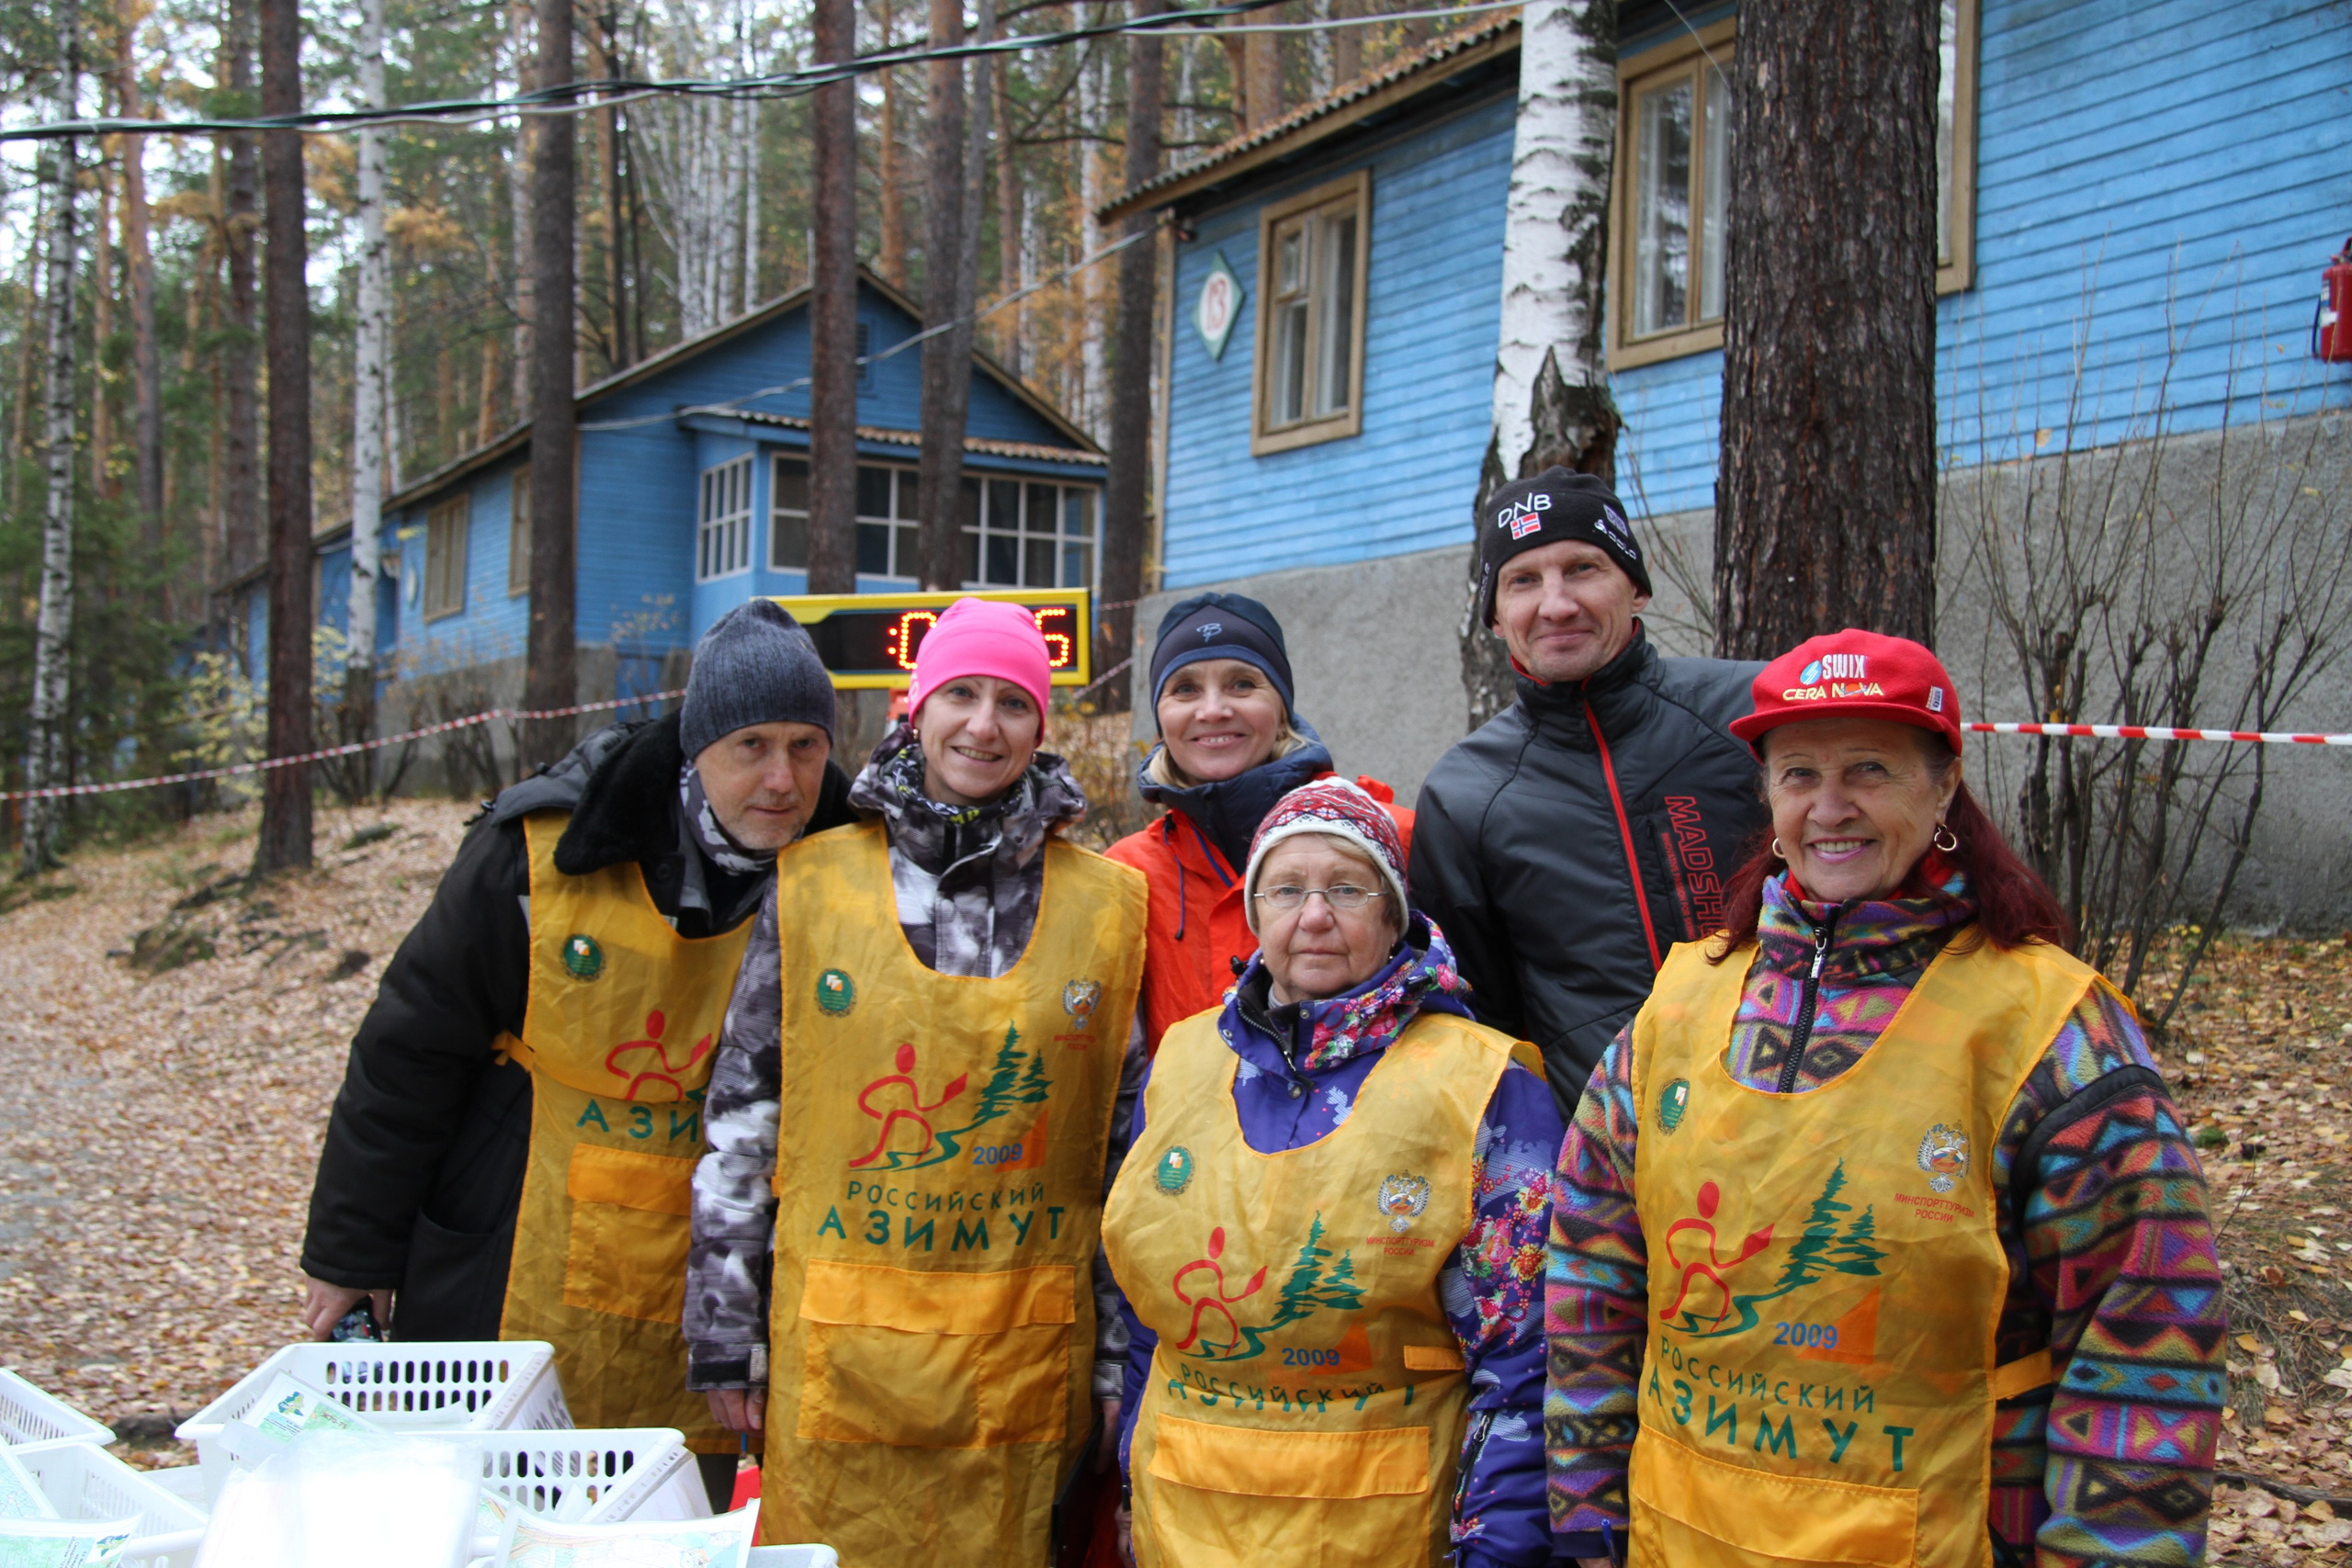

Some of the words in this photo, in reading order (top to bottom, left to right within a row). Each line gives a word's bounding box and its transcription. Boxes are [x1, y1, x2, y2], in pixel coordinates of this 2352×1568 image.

[1498, 491, 1552, 529] DNB
[1821, 653, 1866, 681] SWIX
[1781, 685, 1827, 702] CERA
[575, 1098, 699, 1144] АЗИ
[971, 1143, 1023, 1166] 2009
[846, 1180, 1045, 1213] РОССИЙСКИЙ
[1894, 1192, 1975, 1219] МИНСПОРТТУРИЗМ
[817, 1203, 1065, 1252] АЗИМУТ
[1914, 1208, 1954, 1224] РОССИИ
[1383, 1247, 1415, 1257] РОССИИ
[1774, 1321, 1838, 1349] 2009
[1282, 1348, 1340, 1366] 2009
[1181, 1362, 1385, 1404] РОССИЙСКИЙ
[1661, 1335, 1874, 1414] РОССИЙСКИЙ
[1647, 1361, 1915, 1472] АЗИМУТ
